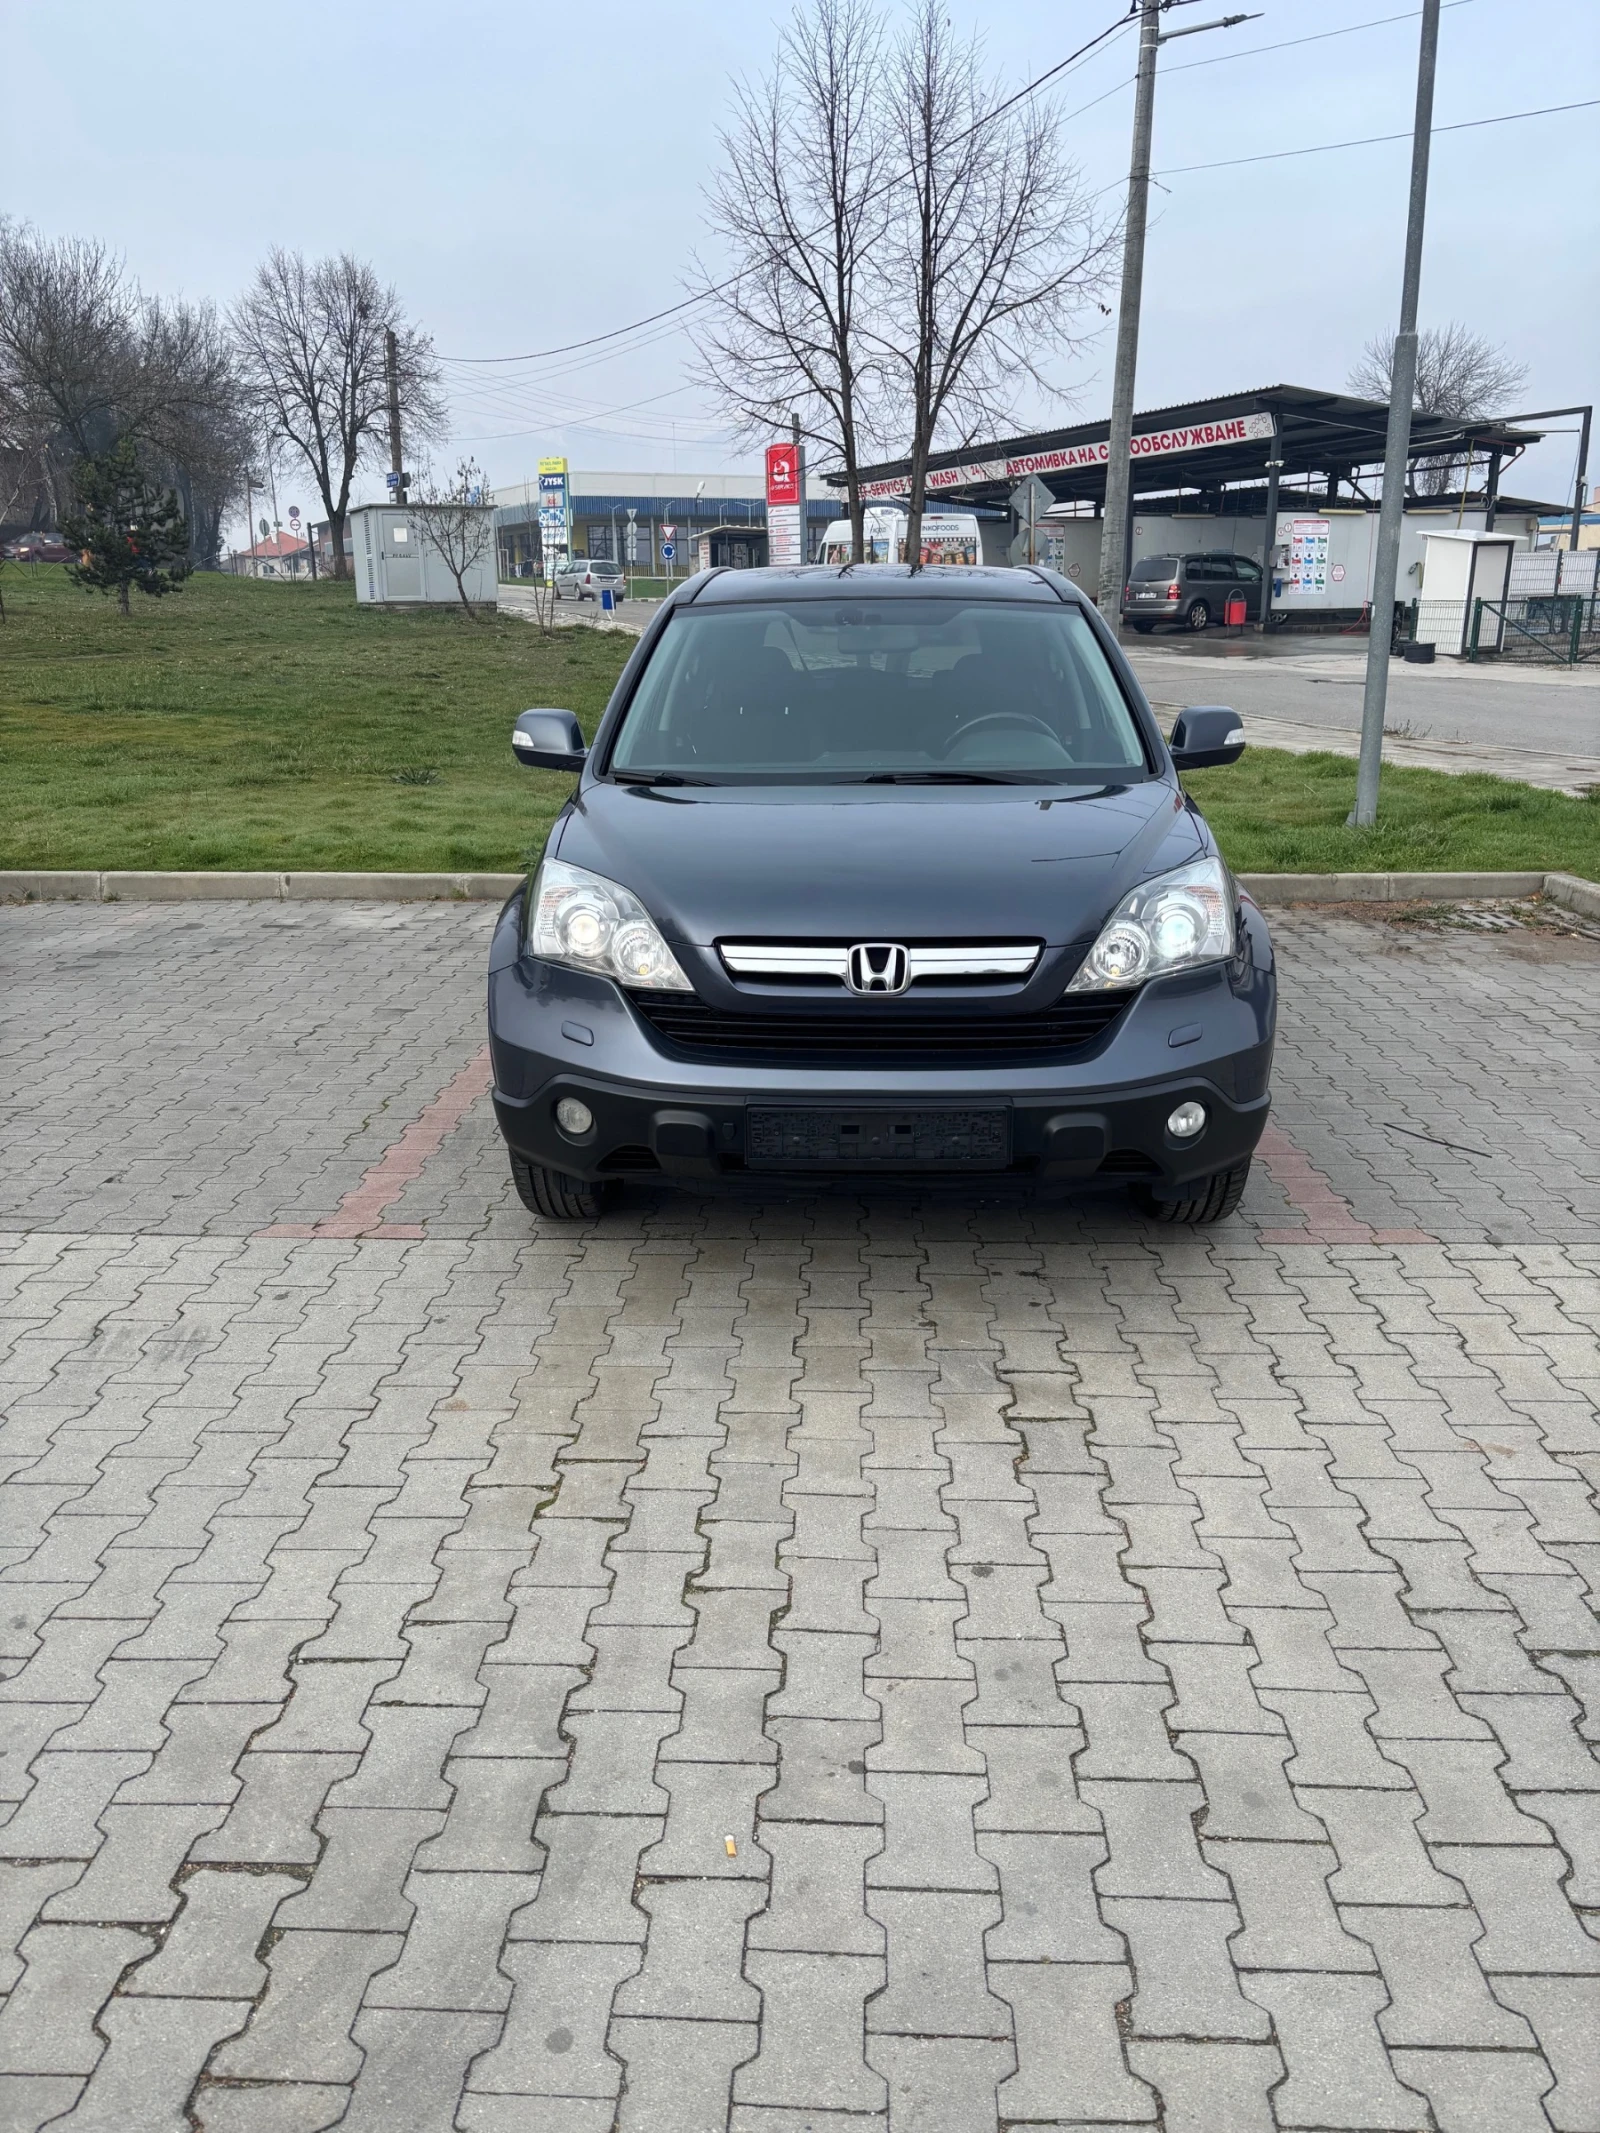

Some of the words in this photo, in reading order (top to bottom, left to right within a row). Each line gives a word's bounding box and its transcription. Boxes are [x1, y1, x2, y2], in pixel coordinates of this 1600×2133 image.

[1006, 450, 1078, 476] АВТОМИВКА
[1078, 446, 1097, 464] НА
[1099, 420, 1247, 460] СООБСЛУЖВАНЕ
[544, 477, 564, 486] JYSK
[857, 478, 905, 501] LF-SERVICE
[929, 469, 959, 487] WASH
